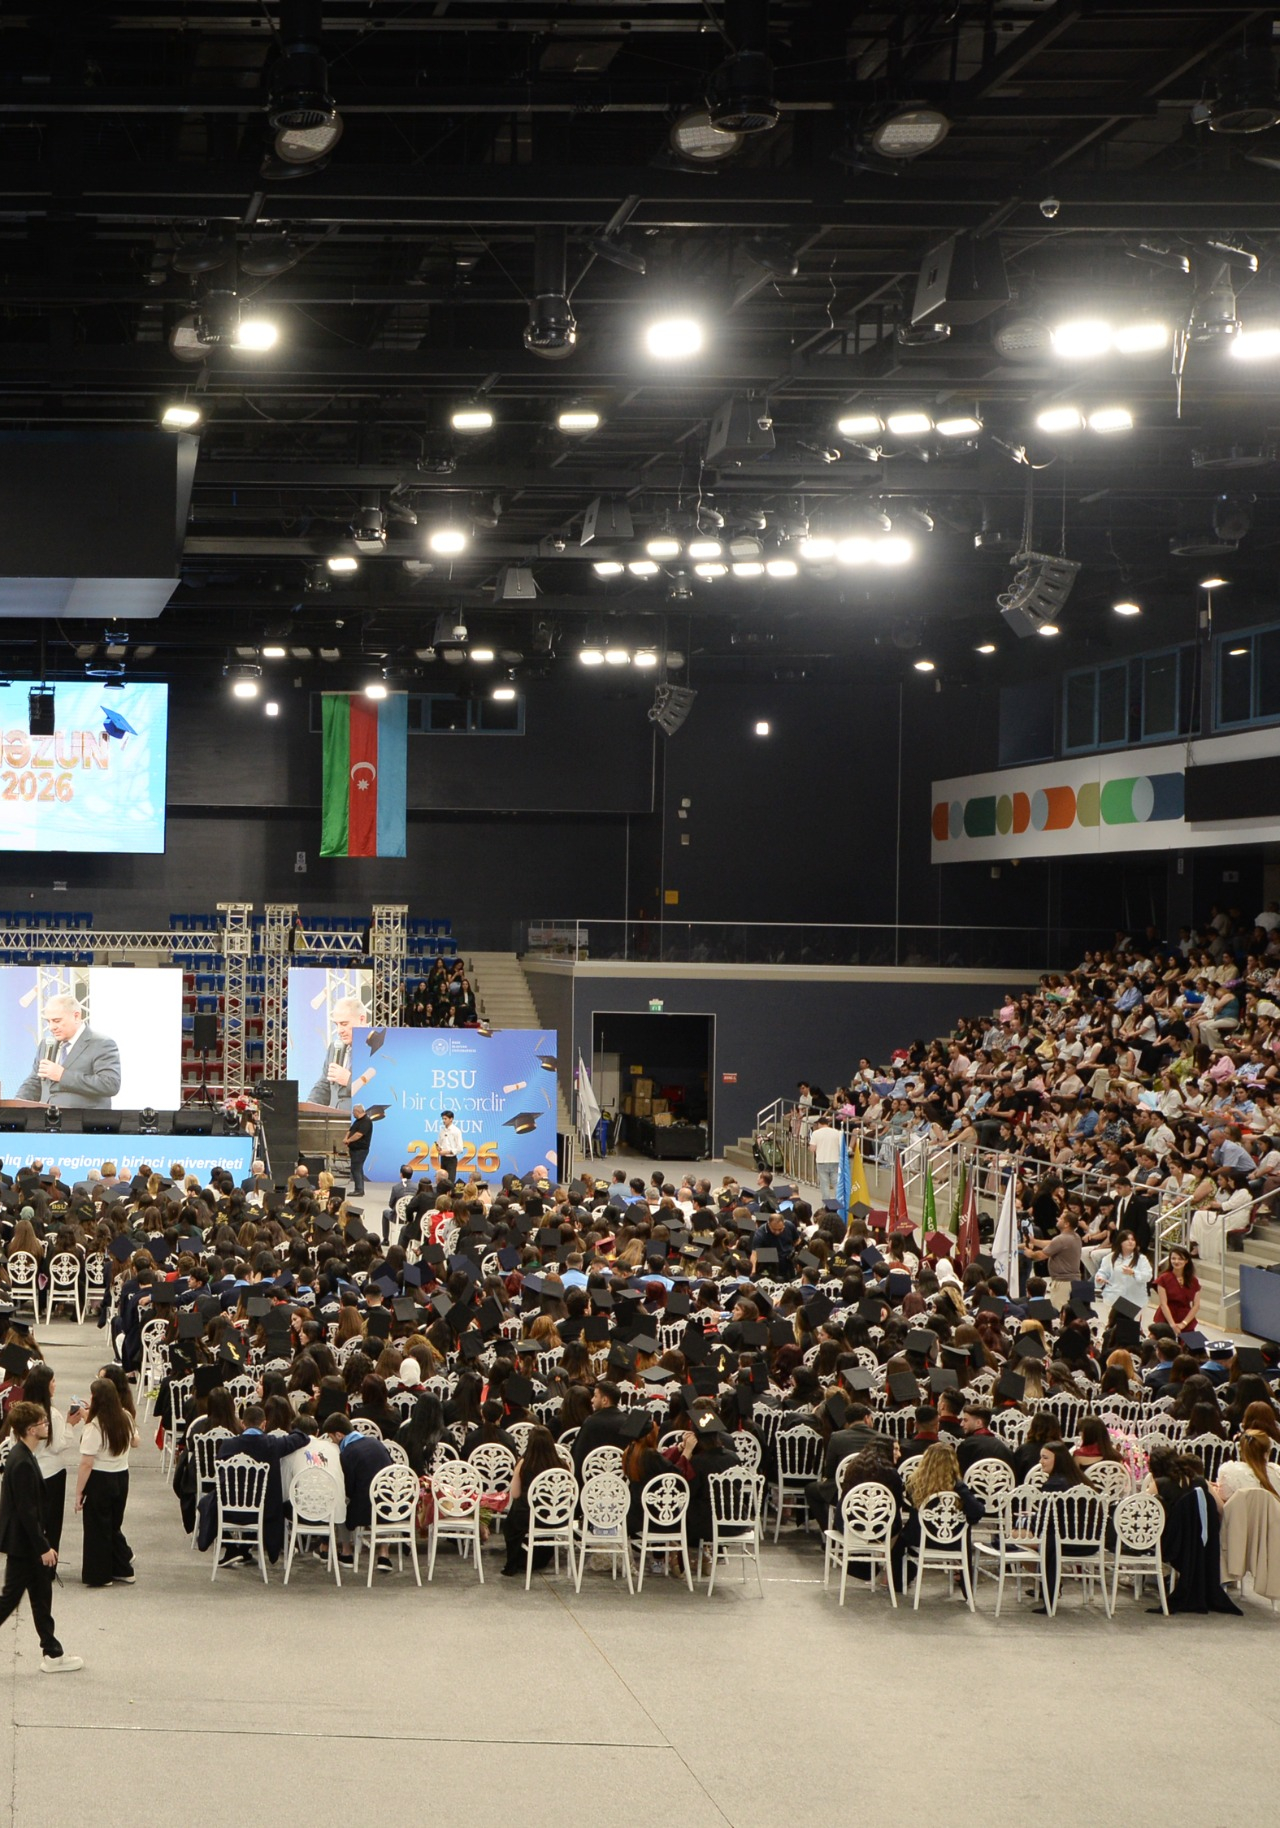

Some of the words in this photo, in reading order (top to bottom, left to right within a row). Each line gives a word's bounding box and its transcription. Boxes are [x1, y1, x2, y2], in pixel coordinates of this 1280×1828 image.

[0, 770, 74, 803] 2026
[431, 1069, 477, 1089] BSU
[402, 1090, 426, 1111] bir
